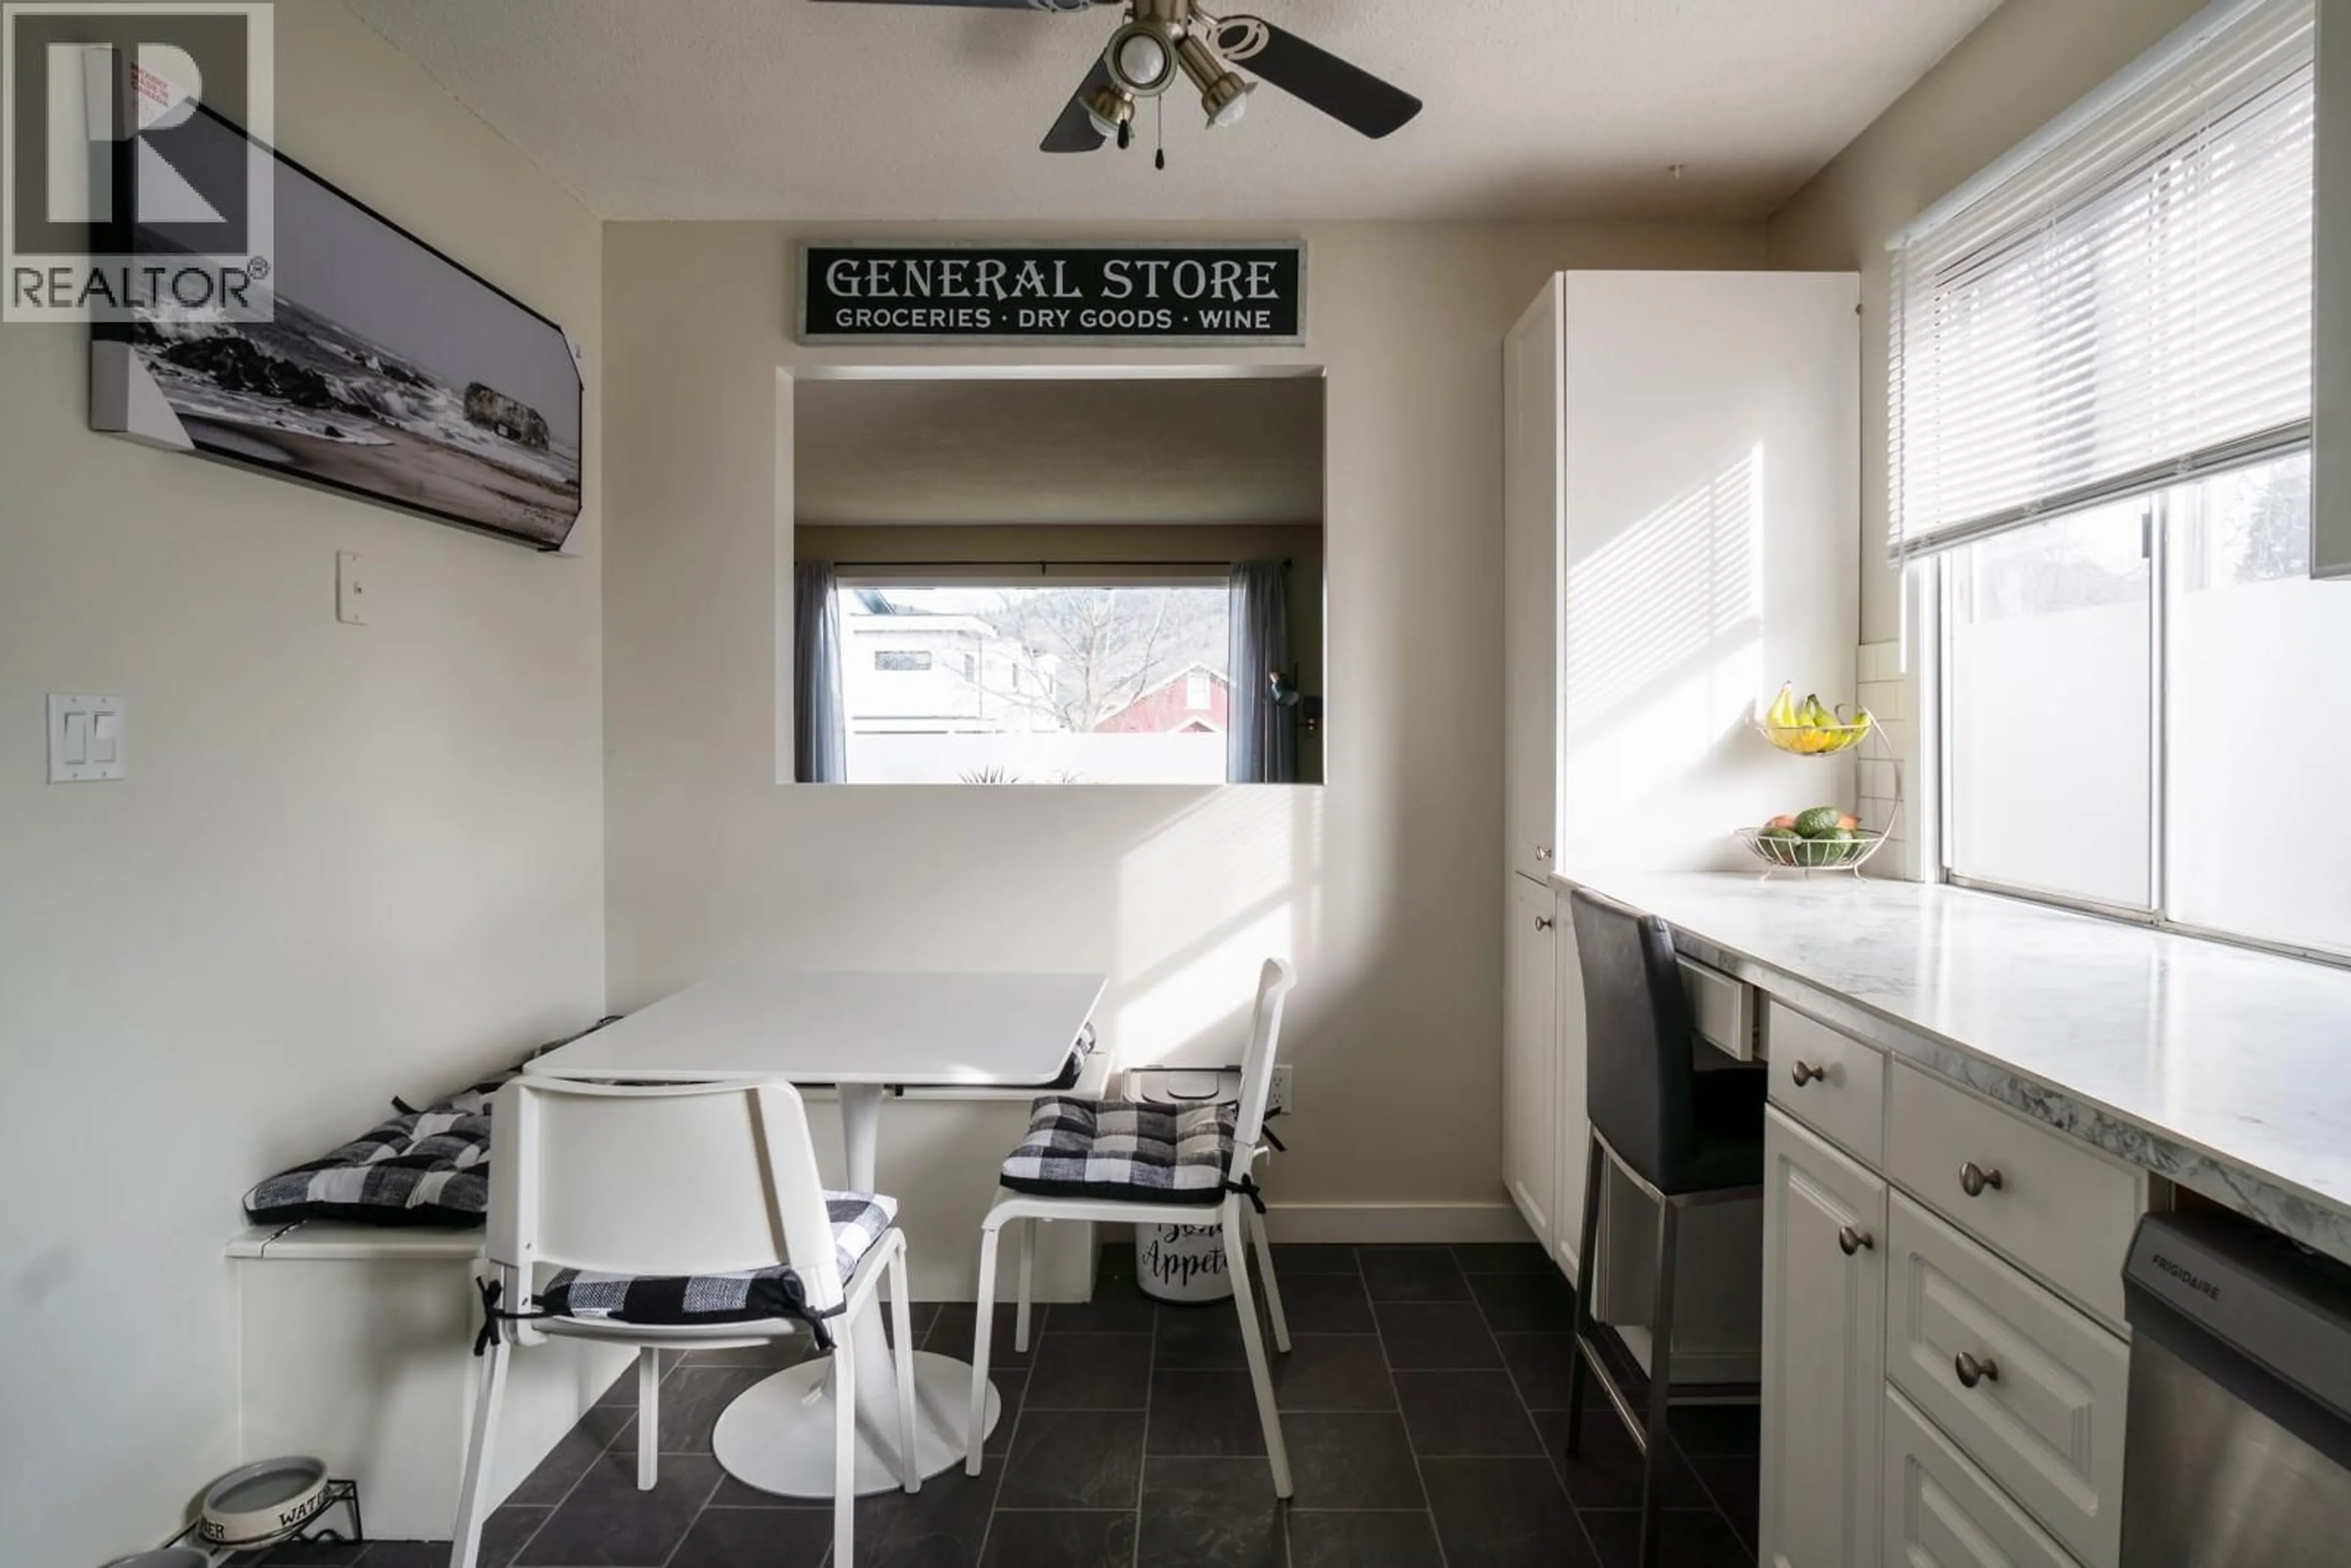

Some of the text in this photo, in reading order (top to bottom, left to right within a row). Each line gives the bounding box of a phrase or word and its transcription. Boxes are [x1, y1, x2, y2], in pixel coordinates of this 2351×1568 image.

[827, 260, 1278, 302] GENERAL STORE
[836, 309, 1270, 328] GROCERIES DRY GOODS WINE
[2151, 1254, 2221, 1300] FRIGIDAIRE
